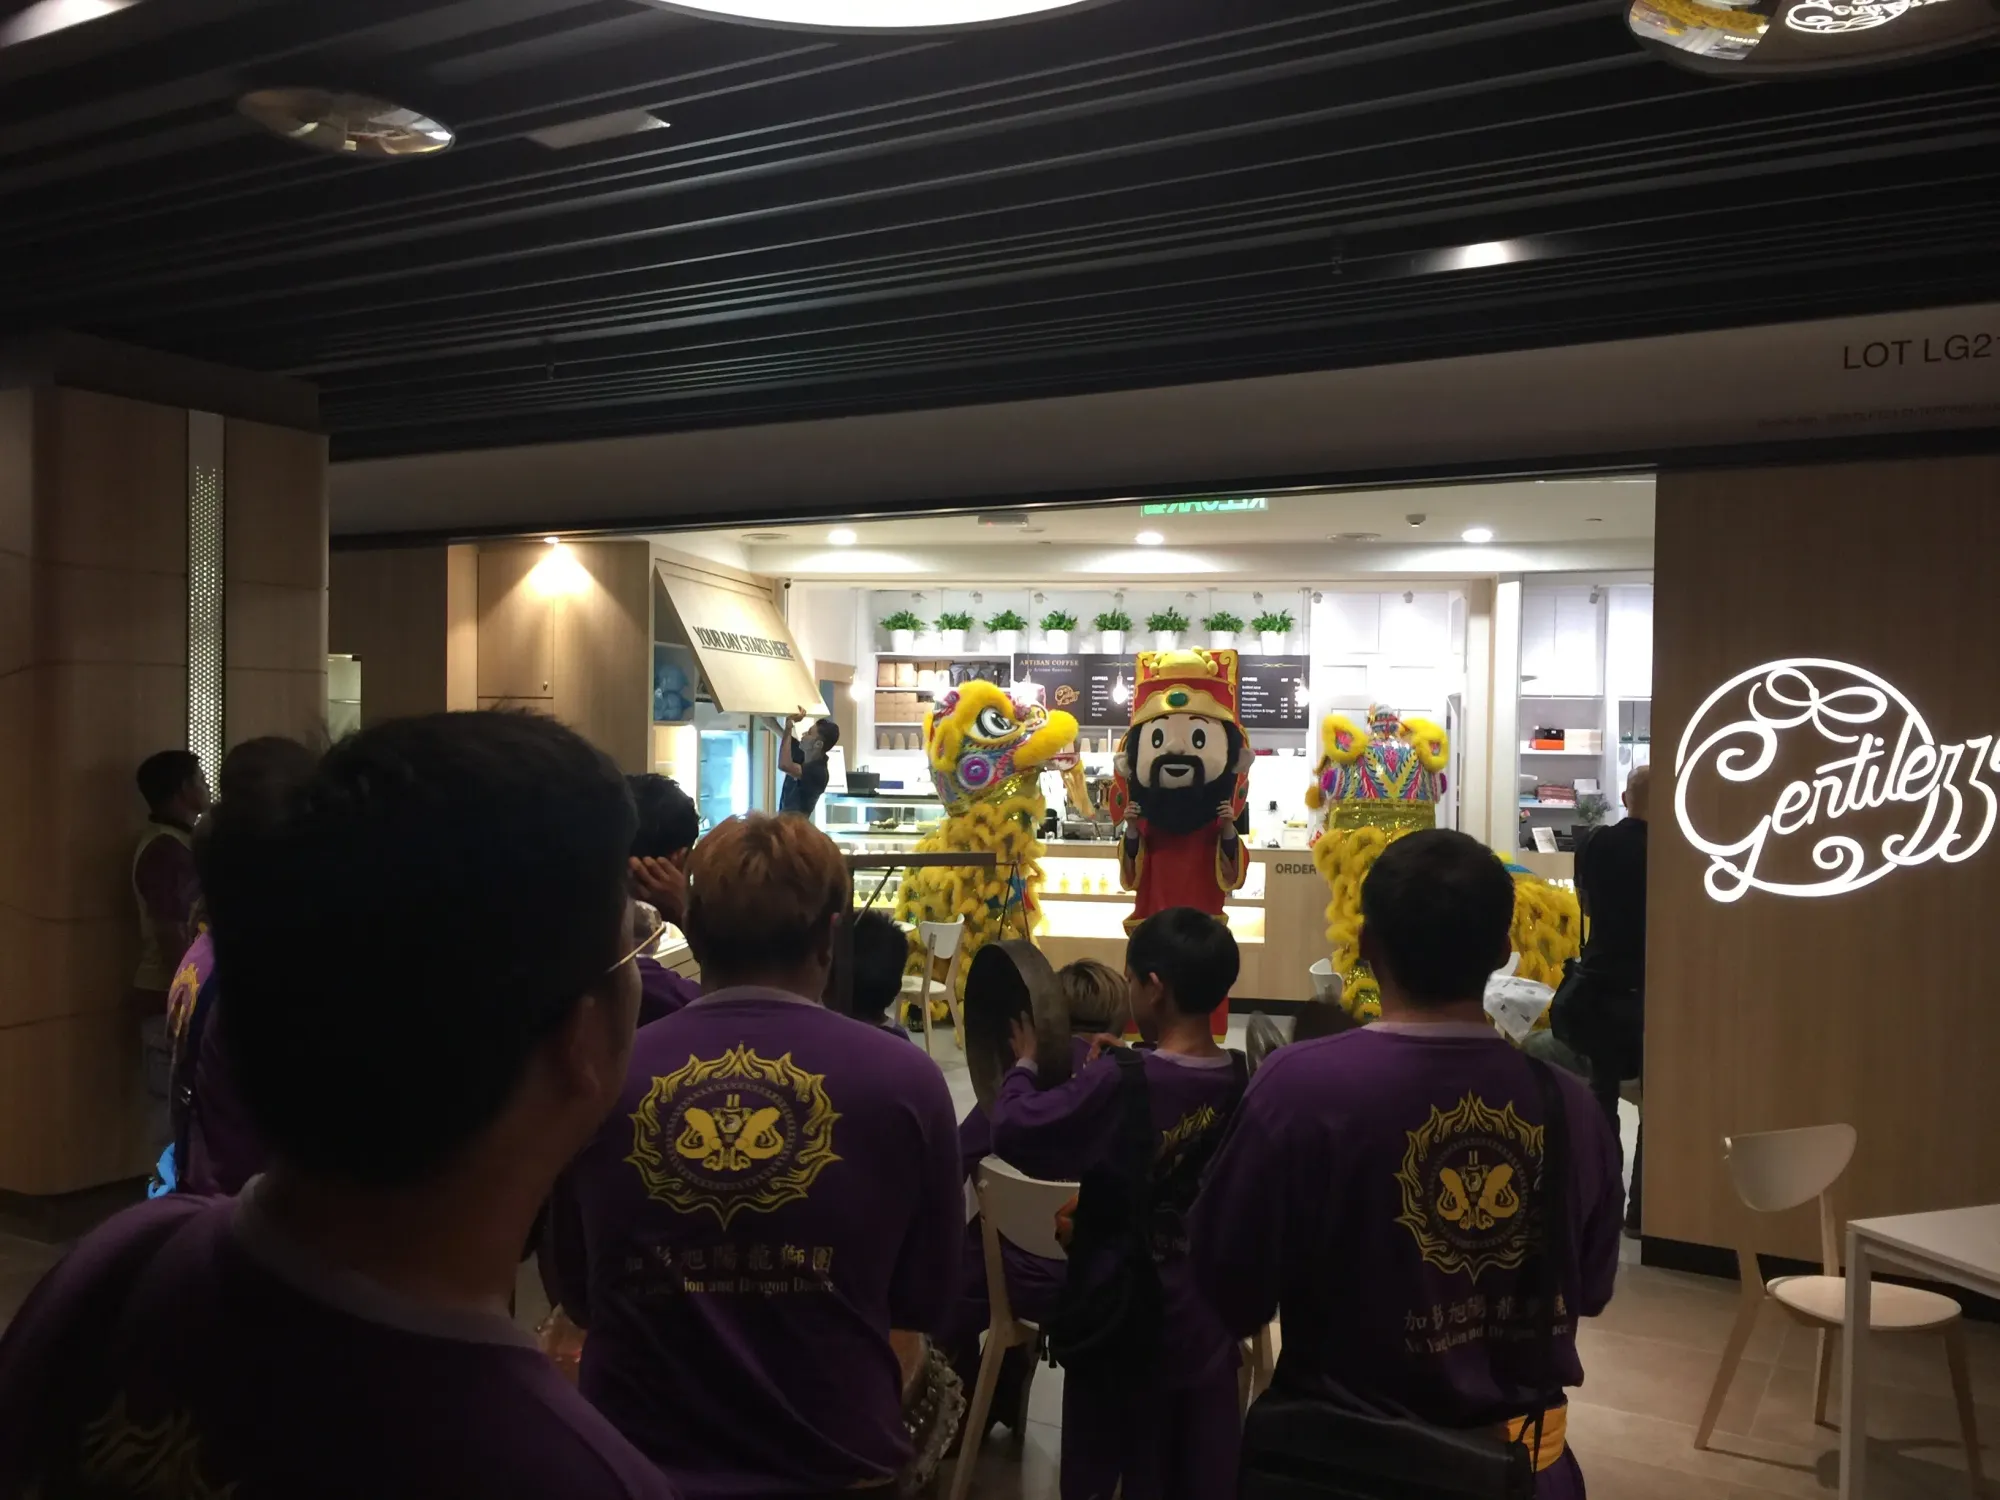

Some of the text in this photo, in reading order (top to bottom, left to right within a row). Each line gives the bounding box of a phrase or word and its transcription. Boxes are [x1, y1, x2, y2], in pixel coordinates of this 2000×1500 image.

[1844, 333, 2000, 370] LOT LG2
[692, 626, 724, 648] YOUR
[720, 632, 743, 652] DAY
[739, 635, 774, 656] STARTS
[1019, 659, 1079, 667] ARTISAN COFFEE
[1674, 665, 2000, 904] Gentilezz
[1275, 863, 1317, 875] ORDER
